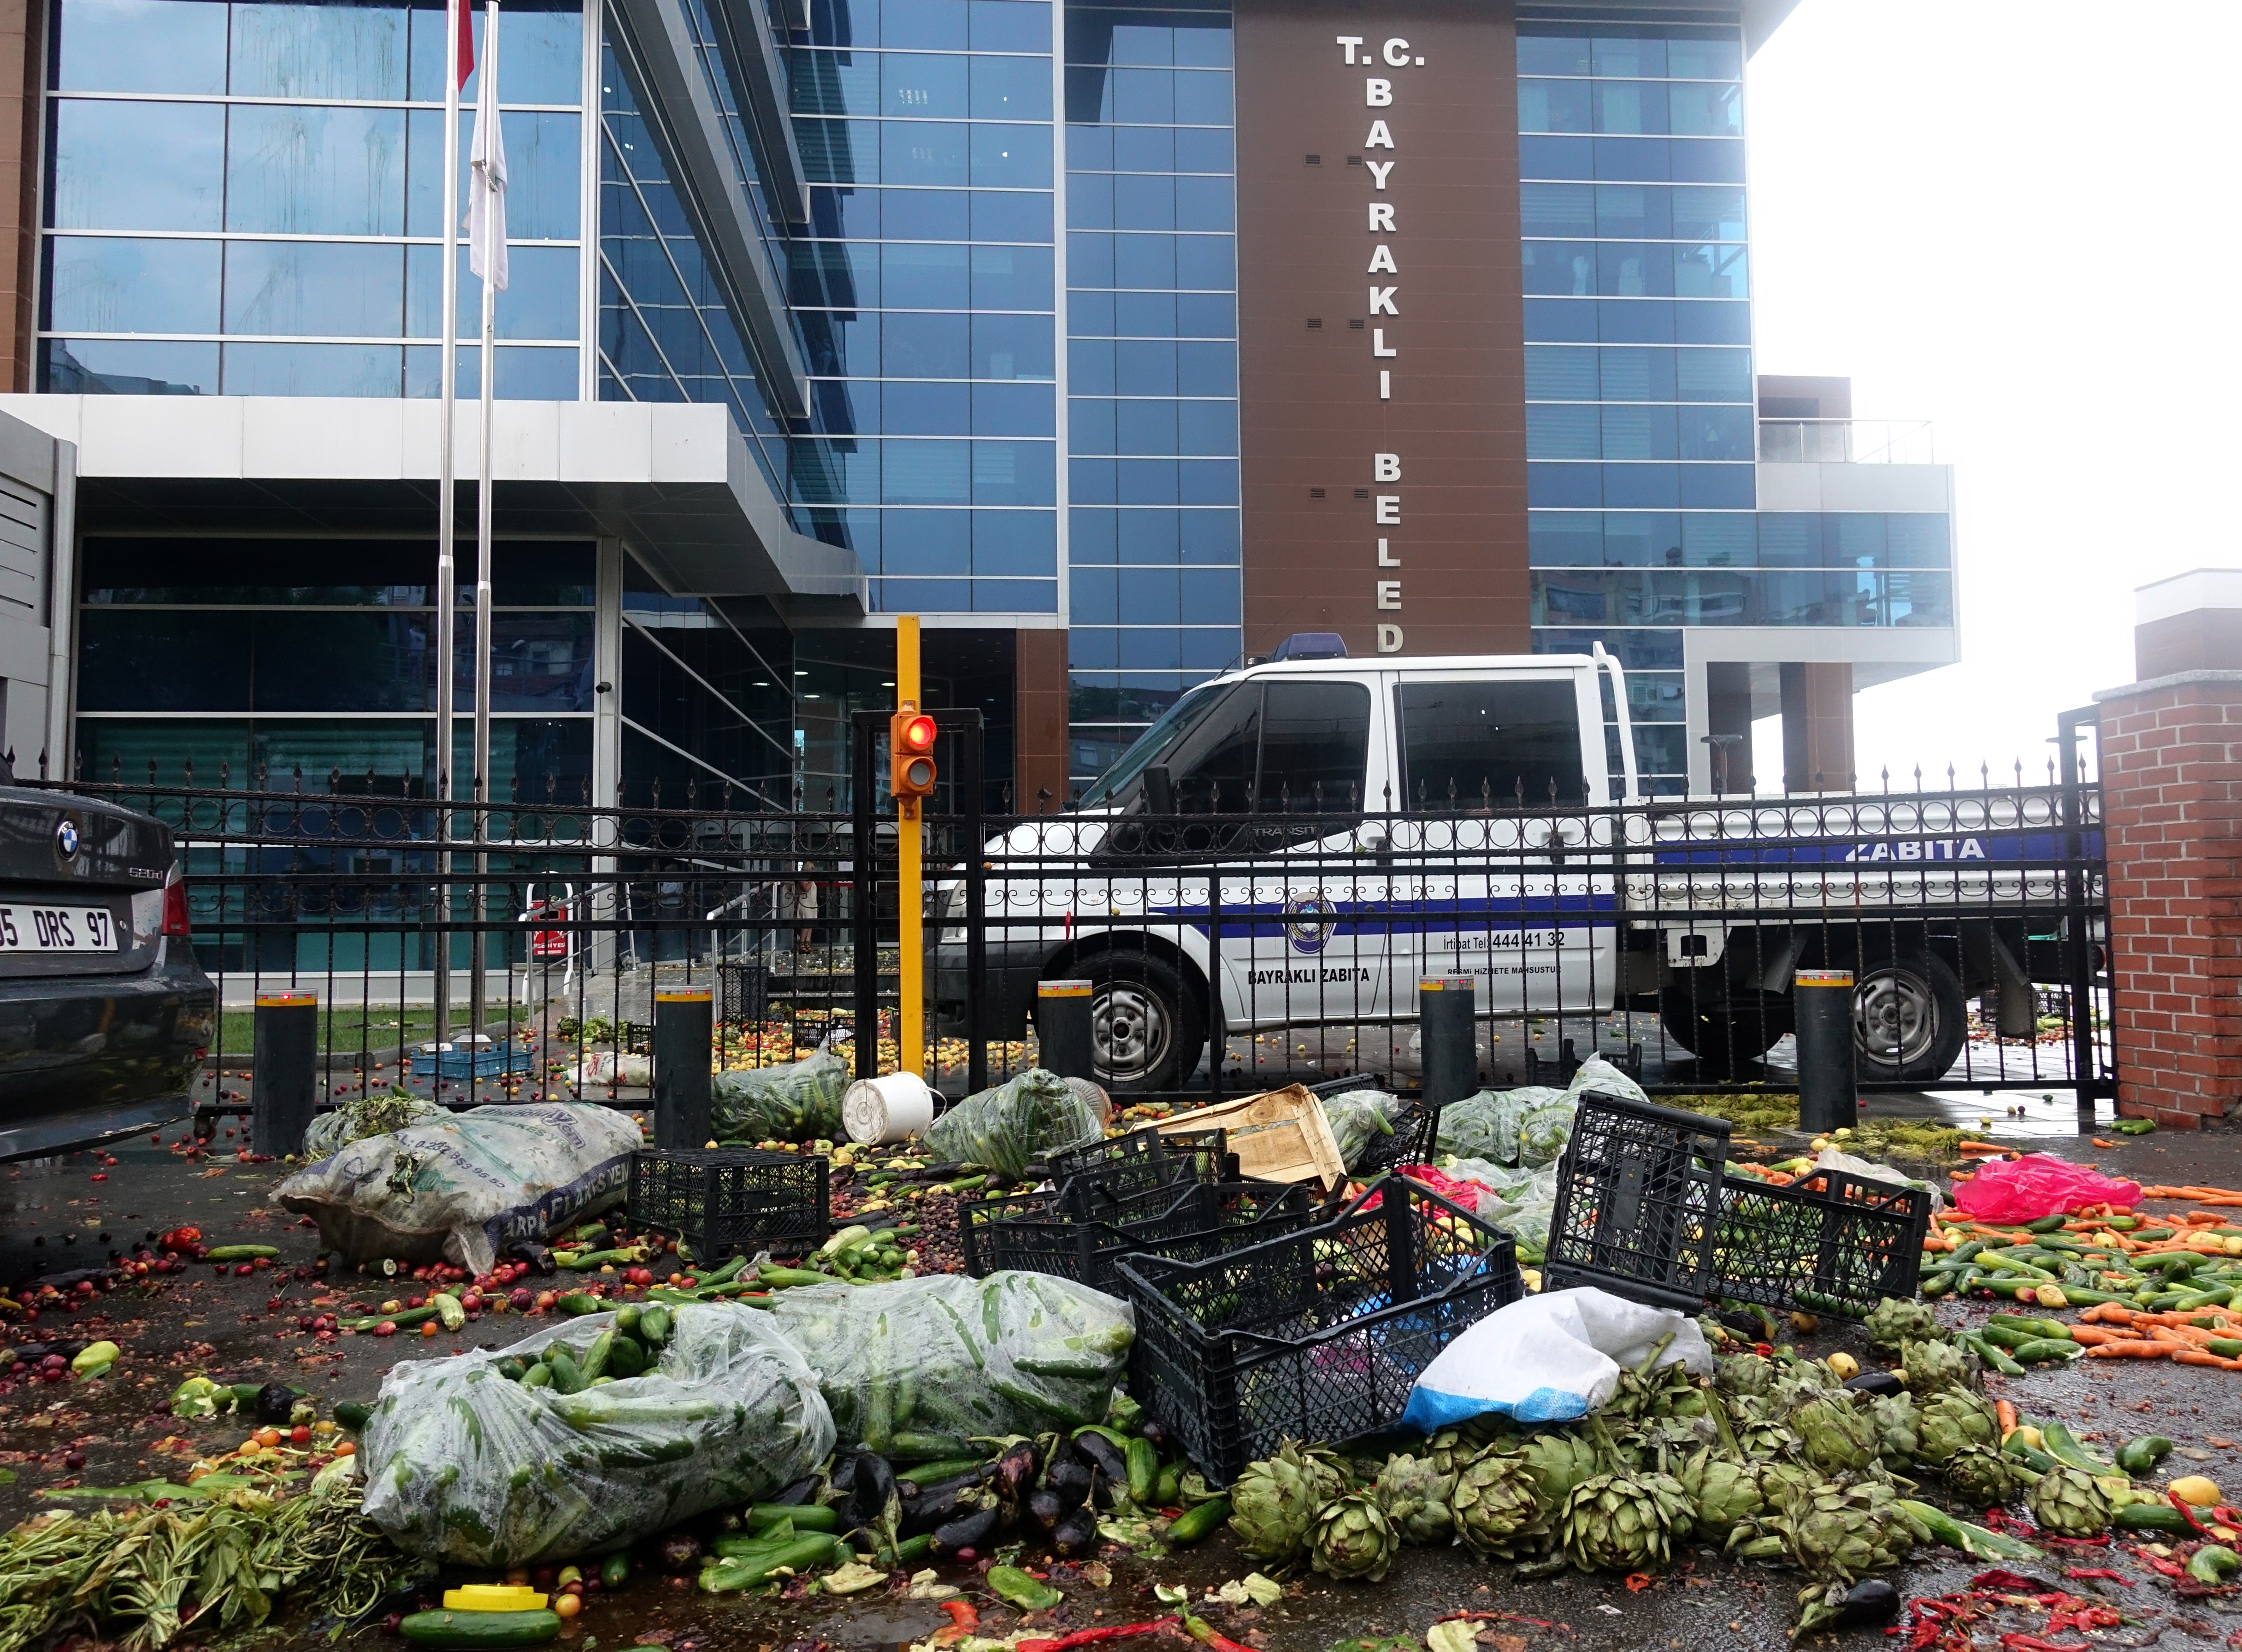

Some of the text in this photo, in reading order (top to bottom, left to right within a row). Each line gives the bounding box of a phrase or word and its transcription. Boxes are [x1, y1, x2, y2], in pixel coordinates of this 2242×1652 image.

[1365, 78, 1403, 653] BAYRAKLI BELED
[1845, 838, 1985, 861] ZABITA
[0, 909, 107, 947] 5 DRS 97
[1493, 933, 1519, 948] 444
[1524, 932, 1540, 947] 41
[1547, 932, 1565, 946] 32
[1248, 969, 1316, 985] BAYRAKLI
